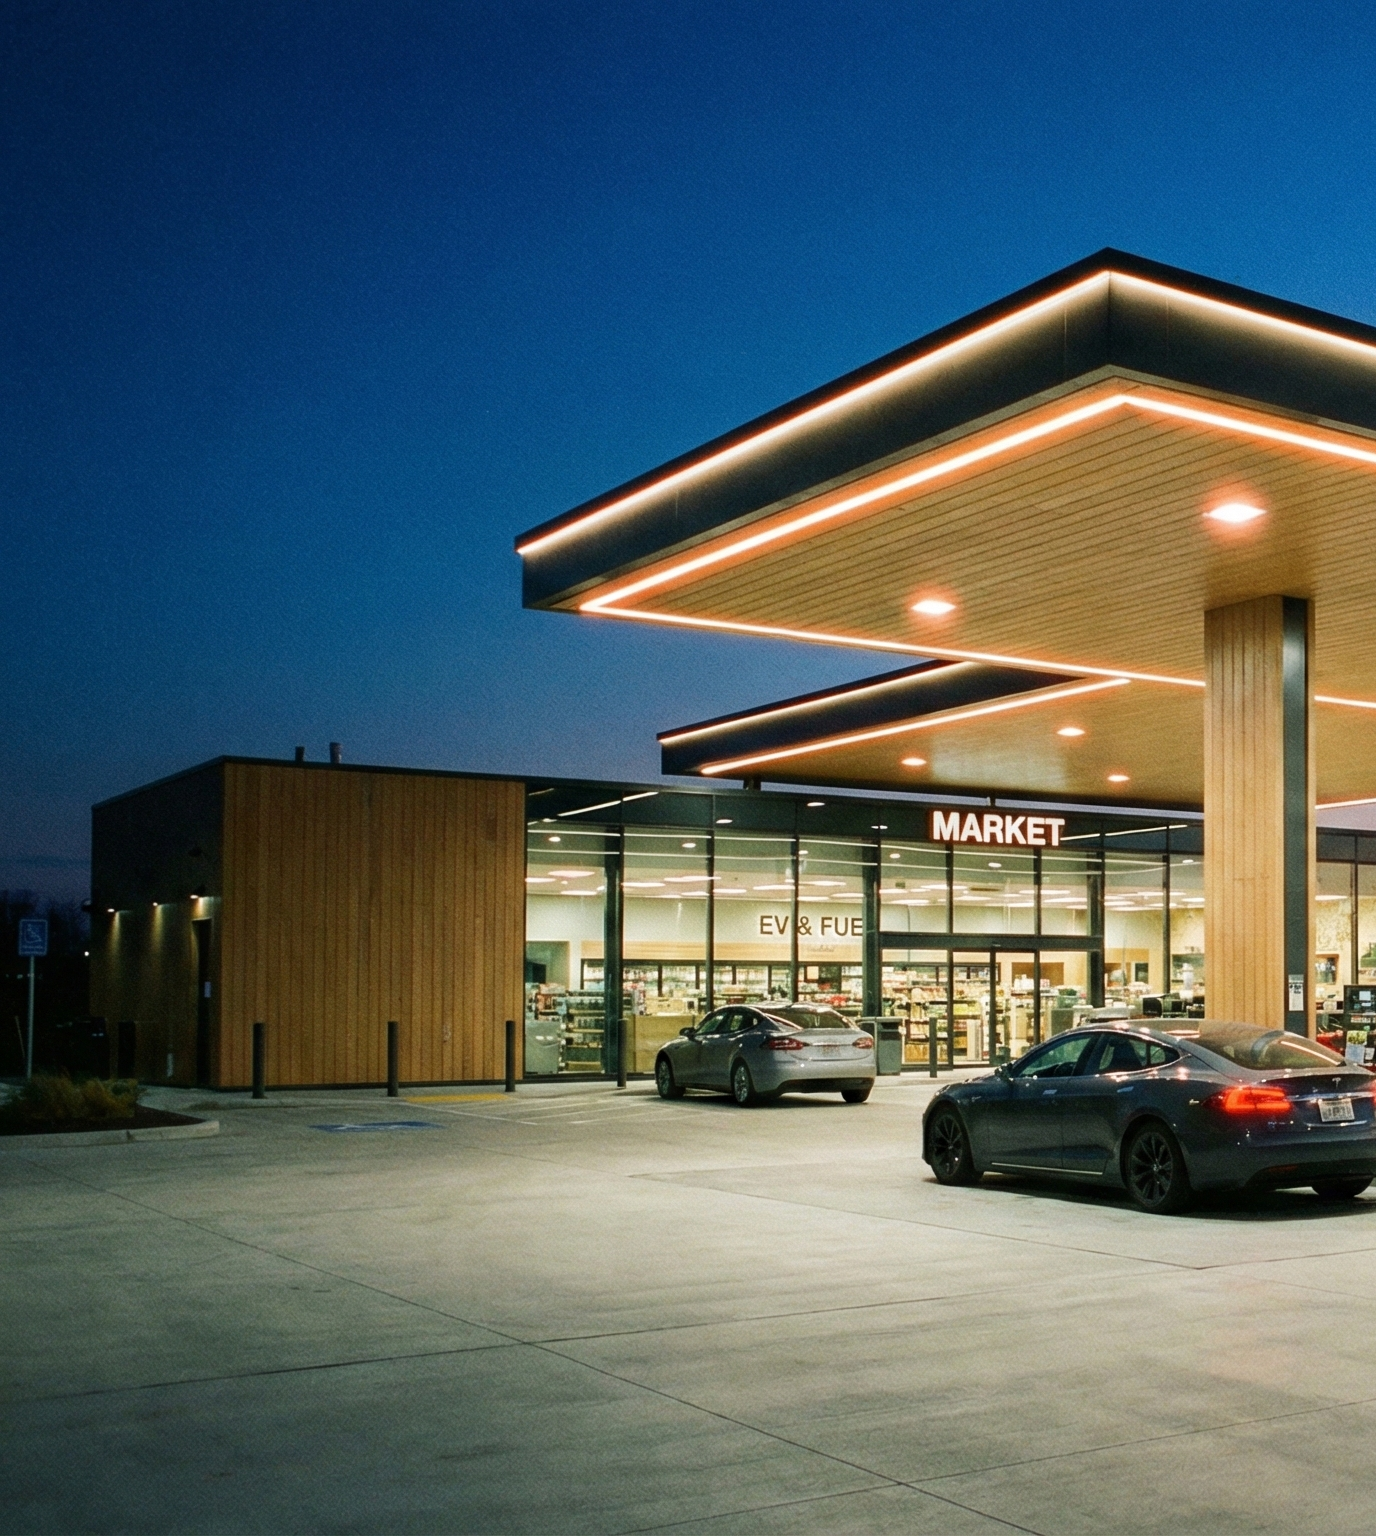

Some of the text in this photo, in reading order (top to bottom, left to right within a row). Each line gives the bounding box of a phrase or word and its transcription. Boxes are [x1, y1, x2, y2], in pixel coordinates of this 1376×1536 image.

[933, 811, 1065, 846] MARKET
[760, 915, 863, 936] EV & FUE
